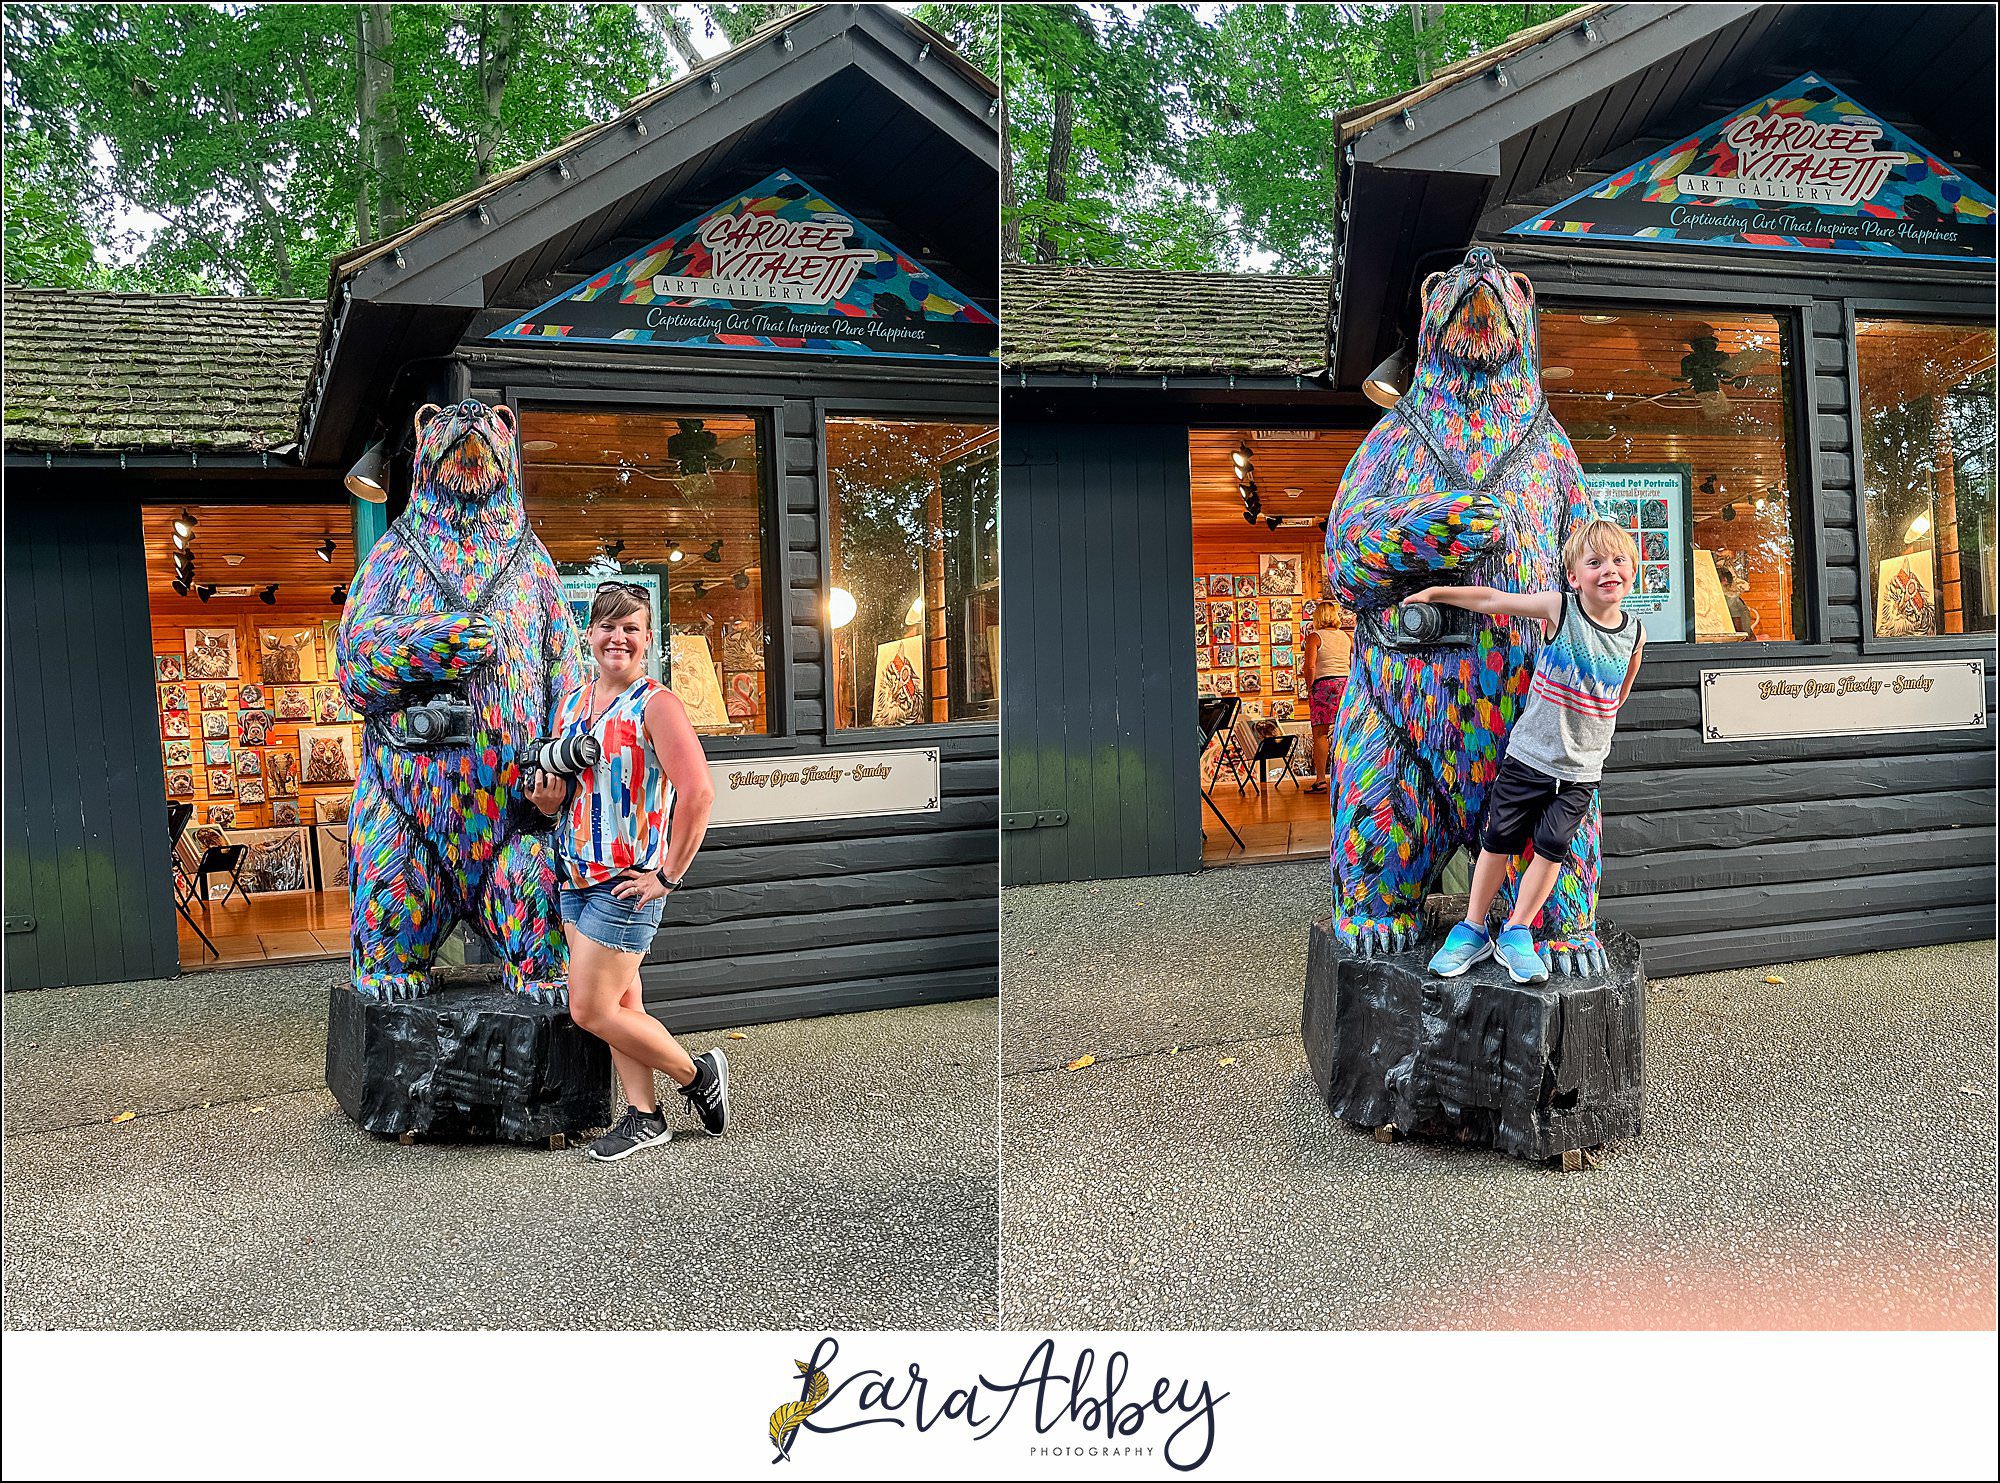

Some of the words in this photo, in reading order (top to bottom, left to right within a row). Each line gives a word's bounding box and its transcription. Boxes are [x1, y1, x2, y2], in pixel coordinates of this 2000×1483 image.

[1732, 119, 1879, 153] CAROLEE
[1686, 179, 1724, 193] ART
[1738, 182, 1833, 200] GALLERY
[706, 220, 850, 251] CAROLEE
[1670, 206, 1748, 233] Captivating
[1752, 213, 1777, 230] Art
[1778, 214, 1812, 233] That
[1814, 218, 1859, 239] Inspires
[1861, 220, 1896, 237] Pure
[1897, 222, 1959, 245] Happiness
[662, 279, 699, 293] ART
[712, 282, 804, 300] GALLERY
[646, 307, 722, 335] Captivating
[726, 313, 751, 331] Art
[751, 314, 784, 332] That
[786, 317, 831, 338] Inspires
[832, 319, 866, 335] Pure
[867, 321, 926, 343] Happiness
[1644, 478, 1679, 488] Portraits
[1758, 680, 1802, 700] Gallery
[1803, 678, 1836, 699] Open
[1837, 675, 1883, 697] Tuesday
[1893, 674, 1935, 695] Sunday
[728, 771, 770, 790] Gallery
[770, 769, 800, 788] Open
[801, 765, 843, 785] Tuesday
[852, 762, 893, 782] Sunday
